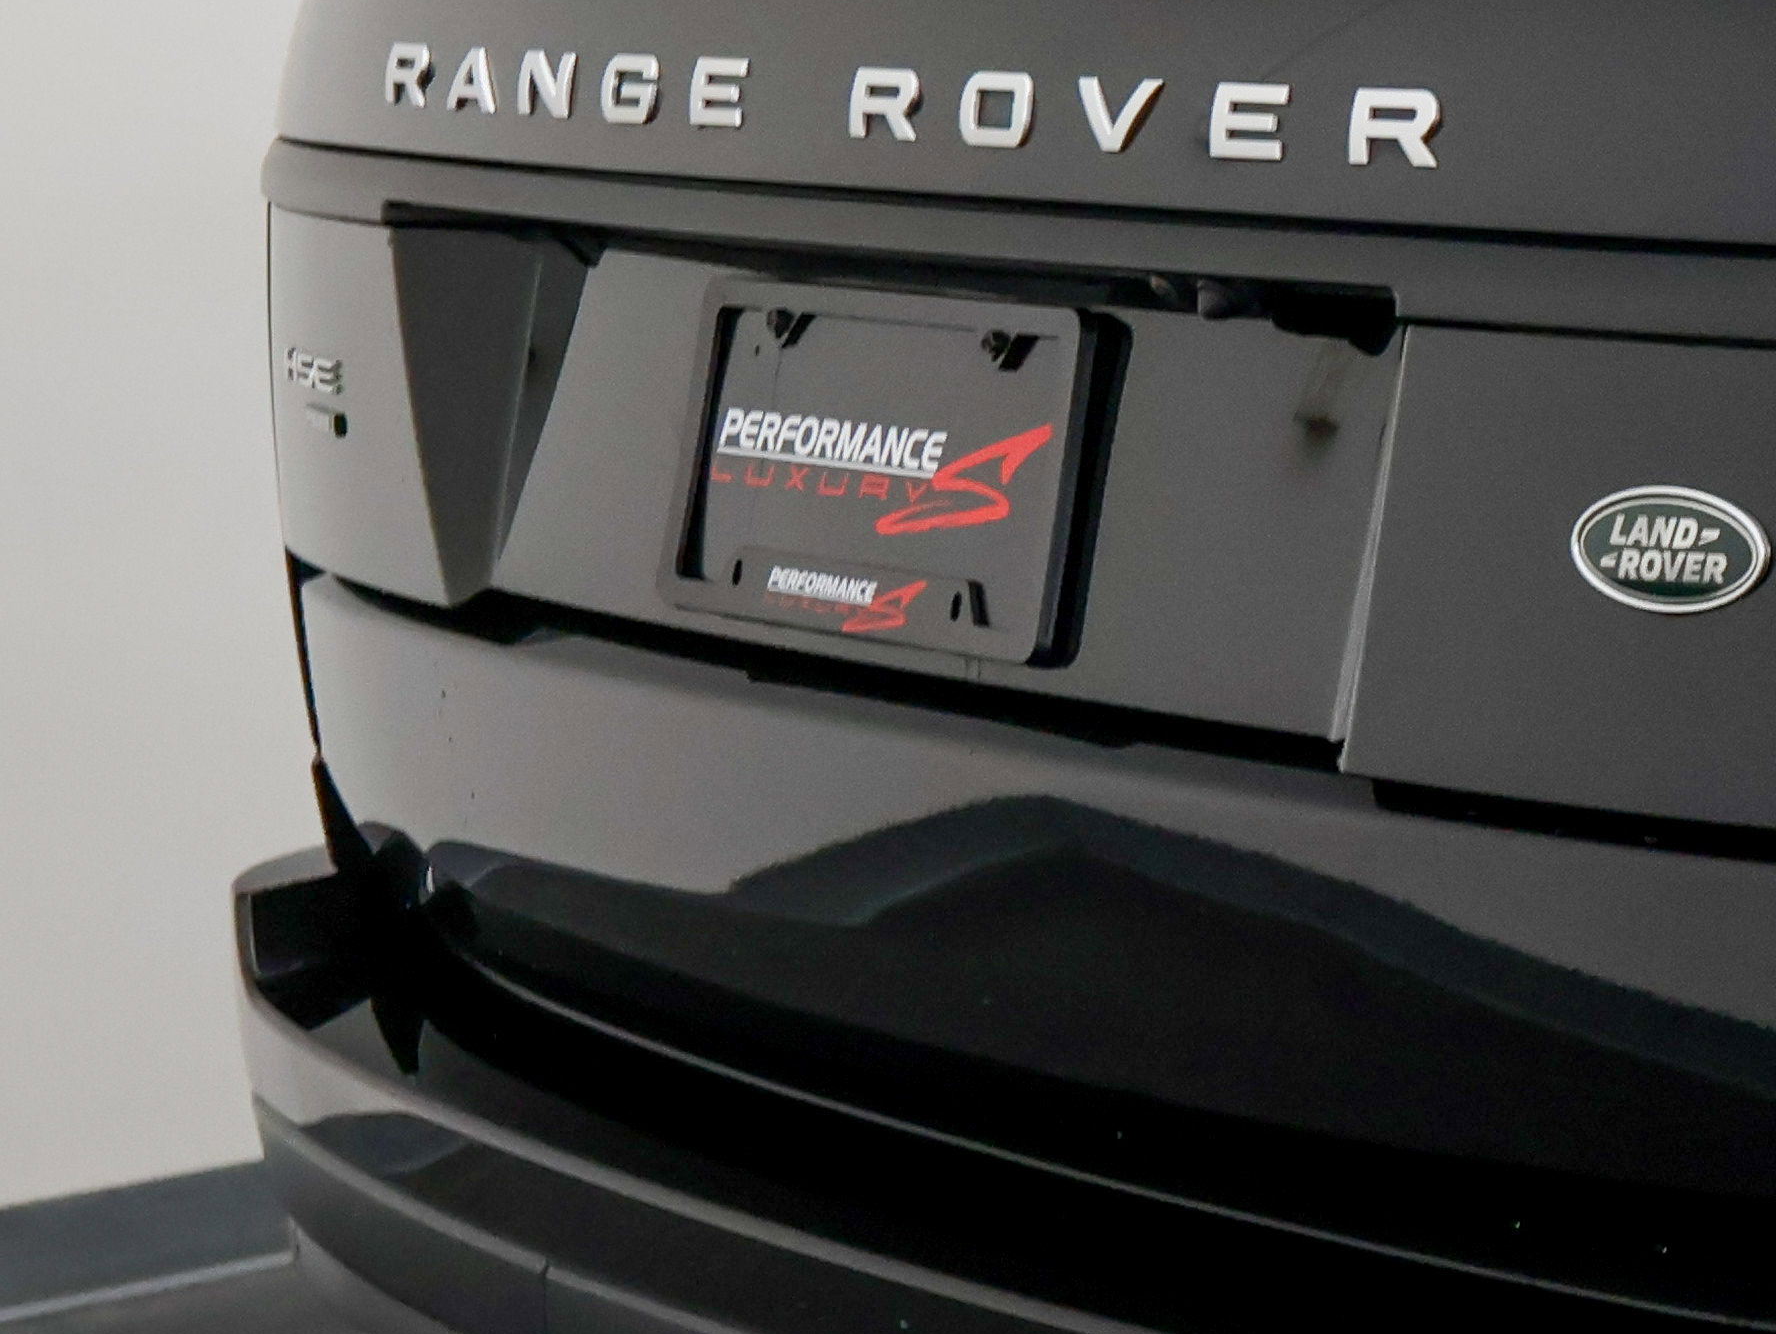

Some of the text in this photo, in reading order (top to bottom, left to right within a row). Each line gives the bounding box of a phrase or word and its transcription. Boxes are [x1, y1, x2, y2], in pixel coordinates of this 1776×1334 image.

[381, 40, 1439, 168] RANGE ROVER
[718, 407, 948, 473] PERFORMANCE
[711, 461, 931, 503] LUXURY
[1609, 513, 1699, 550] LAND
[768, 565, 877, 607] PERFORMANCE
[1617, 547, 1728, 584] ROVER
